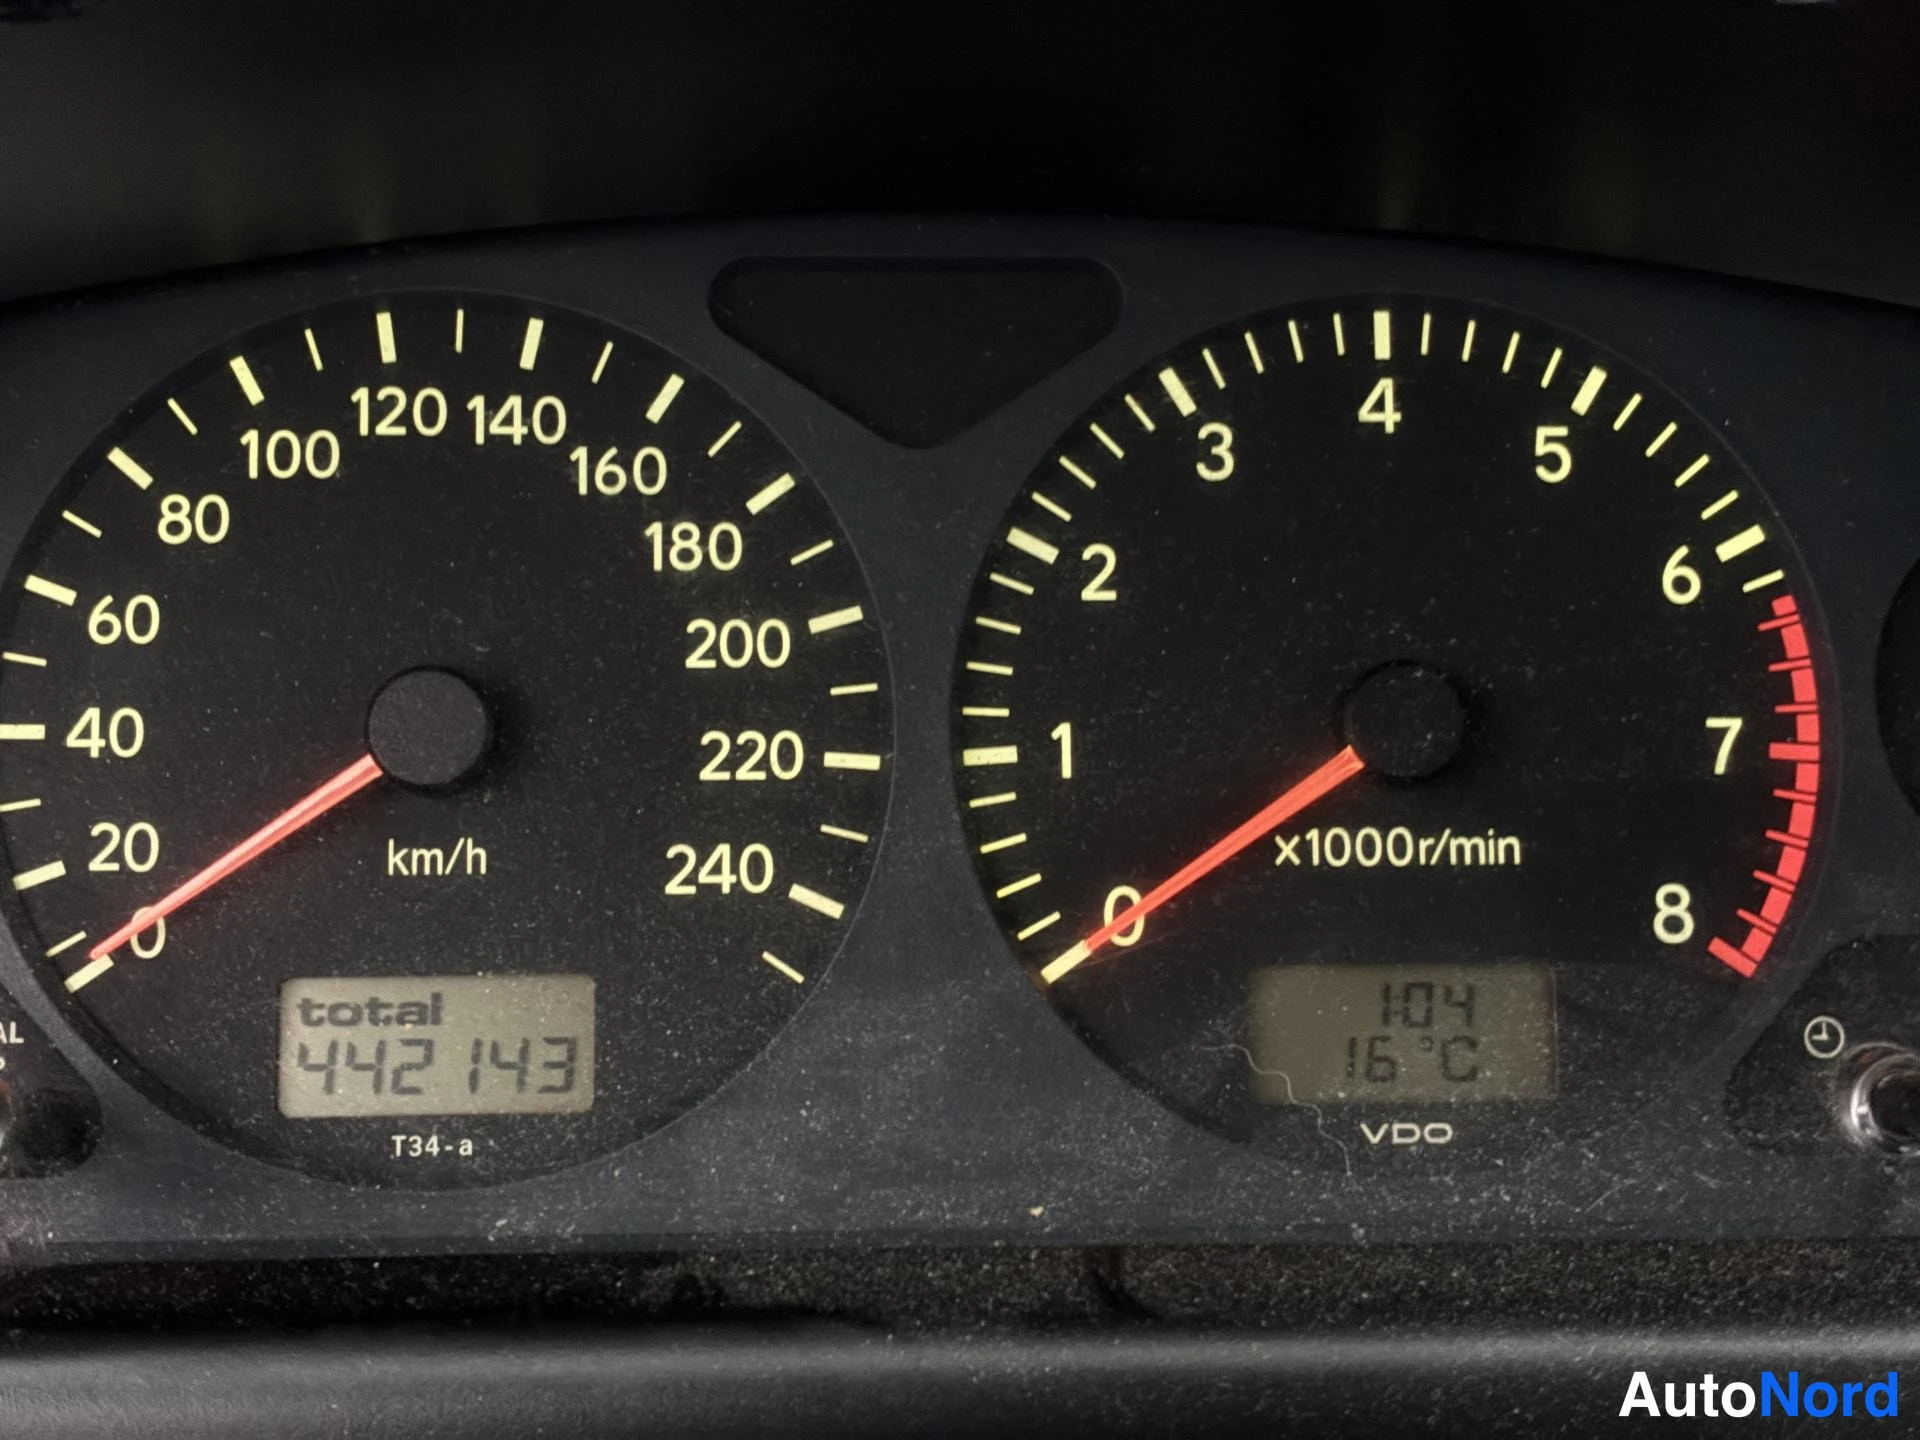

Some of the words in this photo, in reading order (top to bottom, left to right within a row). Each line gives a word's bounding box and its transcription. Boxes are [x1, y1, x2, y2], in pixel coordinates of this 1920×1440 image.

[350, 386, 448, 437] 120
[466, 395, 567, 446] 140
[1358, 377, 1402, 434] 4
[240, 429, 340, 480] 100
[569, 446, 667, 496] 160
[1196, 423, 1235, 482] 3
[1535, 426, 1572, 483] 5
[157, 493, 230, 545] 80
[644, 521, 743, 572] 180
[1080, 543, 1117, 602] 2
[1661, 545, 1701, 605] 6
[87, 594, 160, 645] 60
[685, 618, 791, 669] 200
[65, 706, 145, 759] 40
[699, 729, 804, 781] 220
[1051, 722, 1072, 779] 1
[1705, 717, 1743, 775] 7
[88, 821, 160, 873] 20
[387, 836, 487, 877] km/h
[664, 842, 774, 895] 240
[1275, 827, 1522, 868] x1000r/min
[129, 906, 167, 960] 0
[1102, 885, 1146, 947] 0
[1653, 883, 1695, 944] 8
[297, 993, 443, 1027] total
[297, 1037, 579, 1096] 442143
[1346, 1036, 1397, 1084] 16
[391, 1134, 474, 1158] T34-a
[1360, 1122, 1454, 1145] VDO
